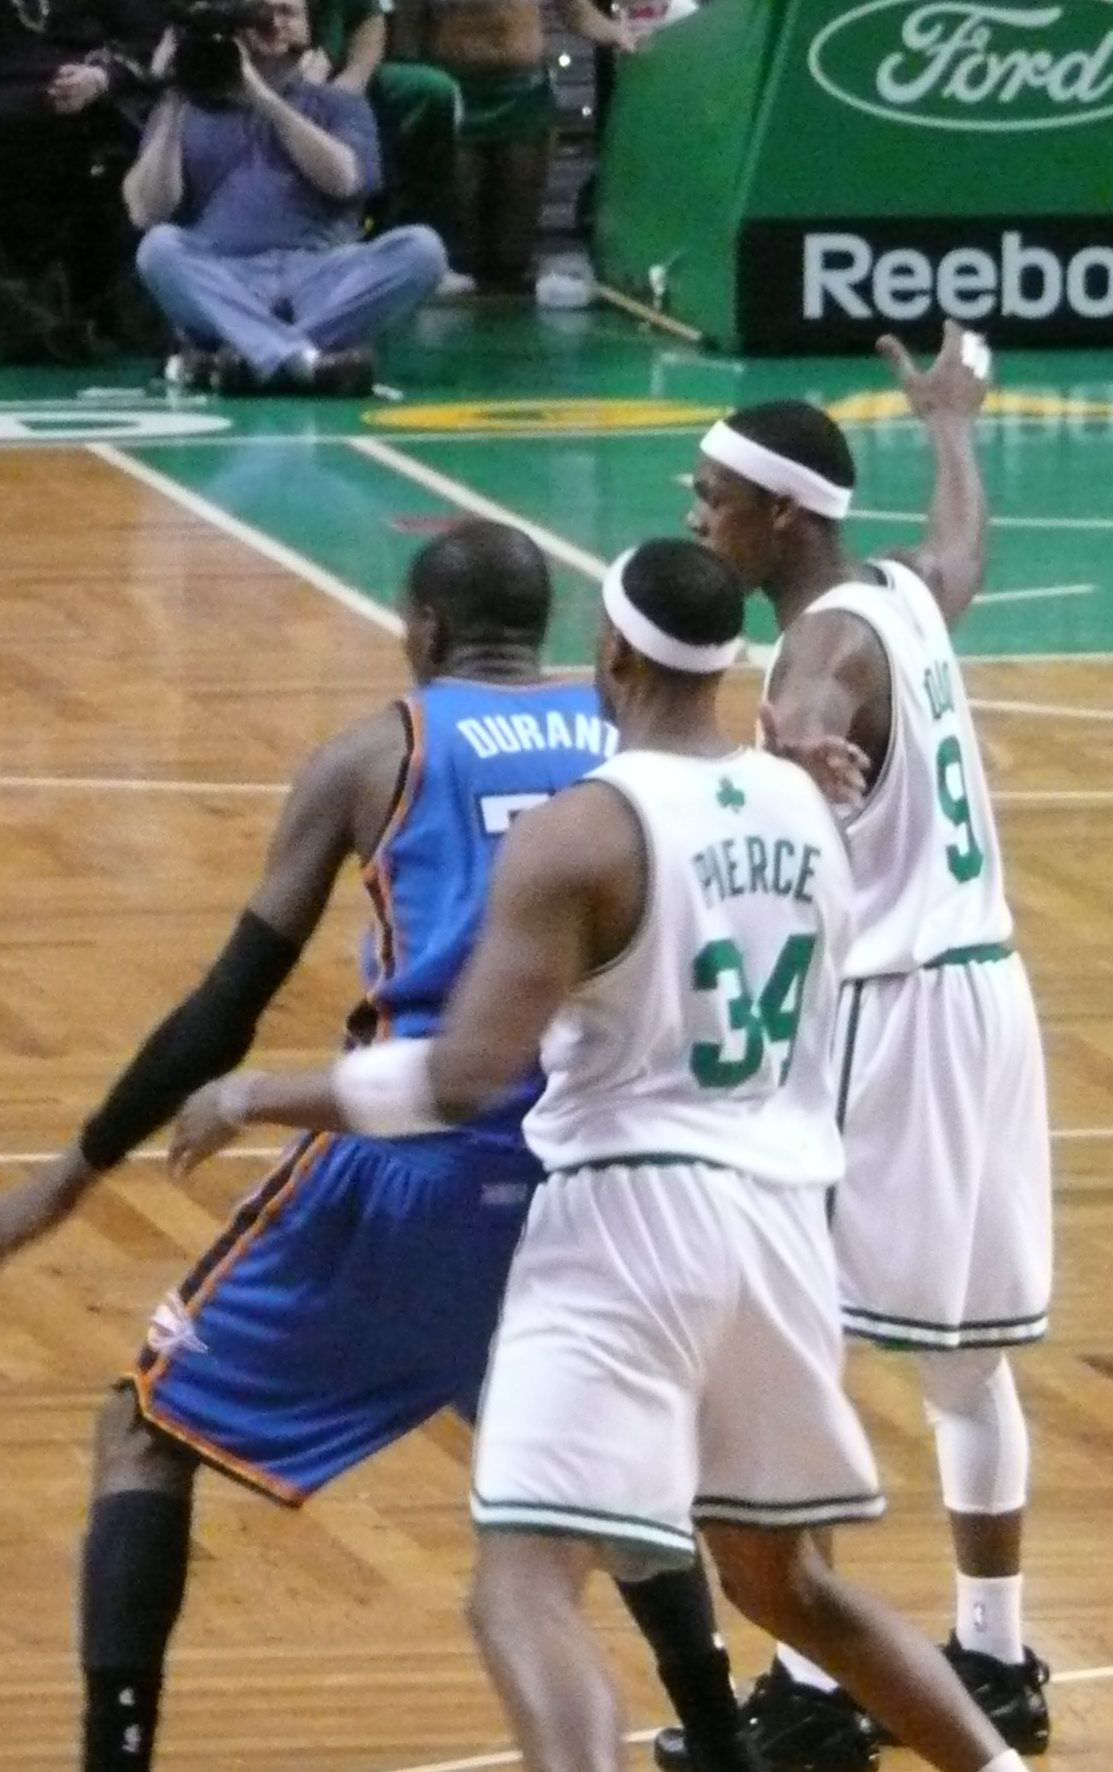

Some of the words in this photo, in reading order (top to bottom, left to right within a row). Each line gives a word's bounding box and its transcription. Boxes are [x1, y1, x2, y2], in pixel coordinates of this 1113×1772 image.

[876, 3, 1113, 103] Ford
[936, 735, 983, 883] 9
[692, 836, 820, 909] PIERCE
[691, 933, 816, 1088] 34
